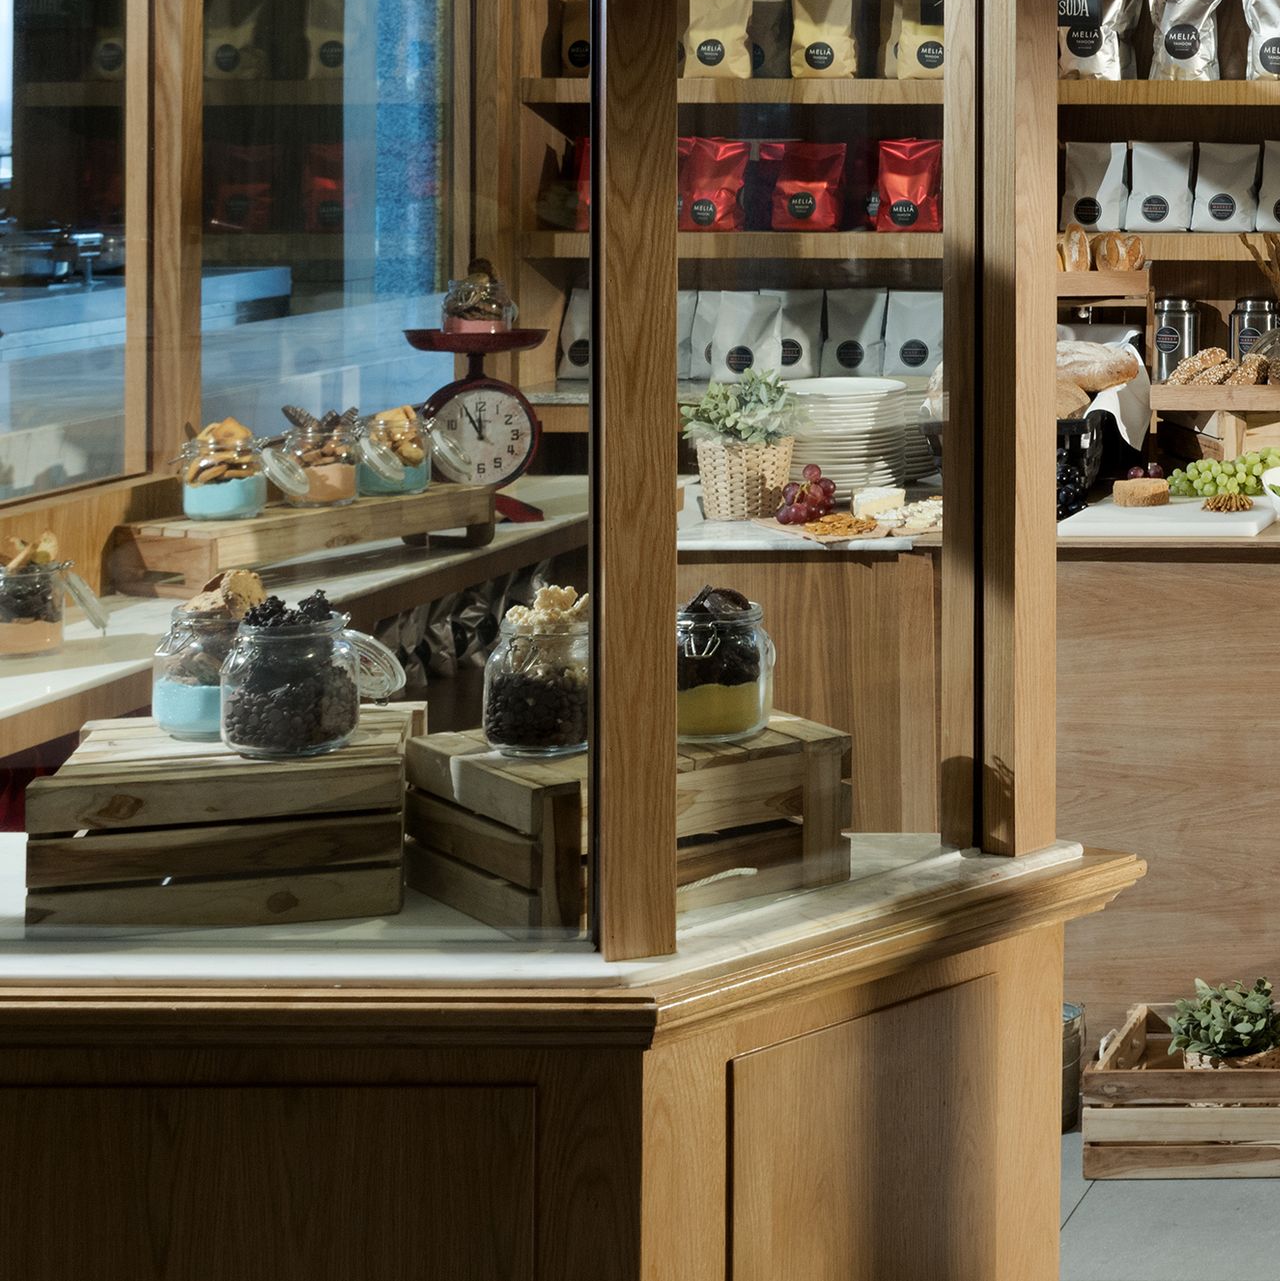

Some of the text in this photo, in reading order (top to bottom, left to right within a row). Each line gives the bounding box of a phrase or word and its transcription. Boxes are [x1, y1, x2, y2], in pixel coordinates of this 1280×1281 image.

[476, 401, 486, 412] 12
[504, 414, 513, 425] 2
[447, 421, 457, 431] 10
[511, 429, 519, 440] 3
[507, 445, 515, 455] 4
[477, 463, 485, 474] 6
[493, 458, 502, 468] 5
